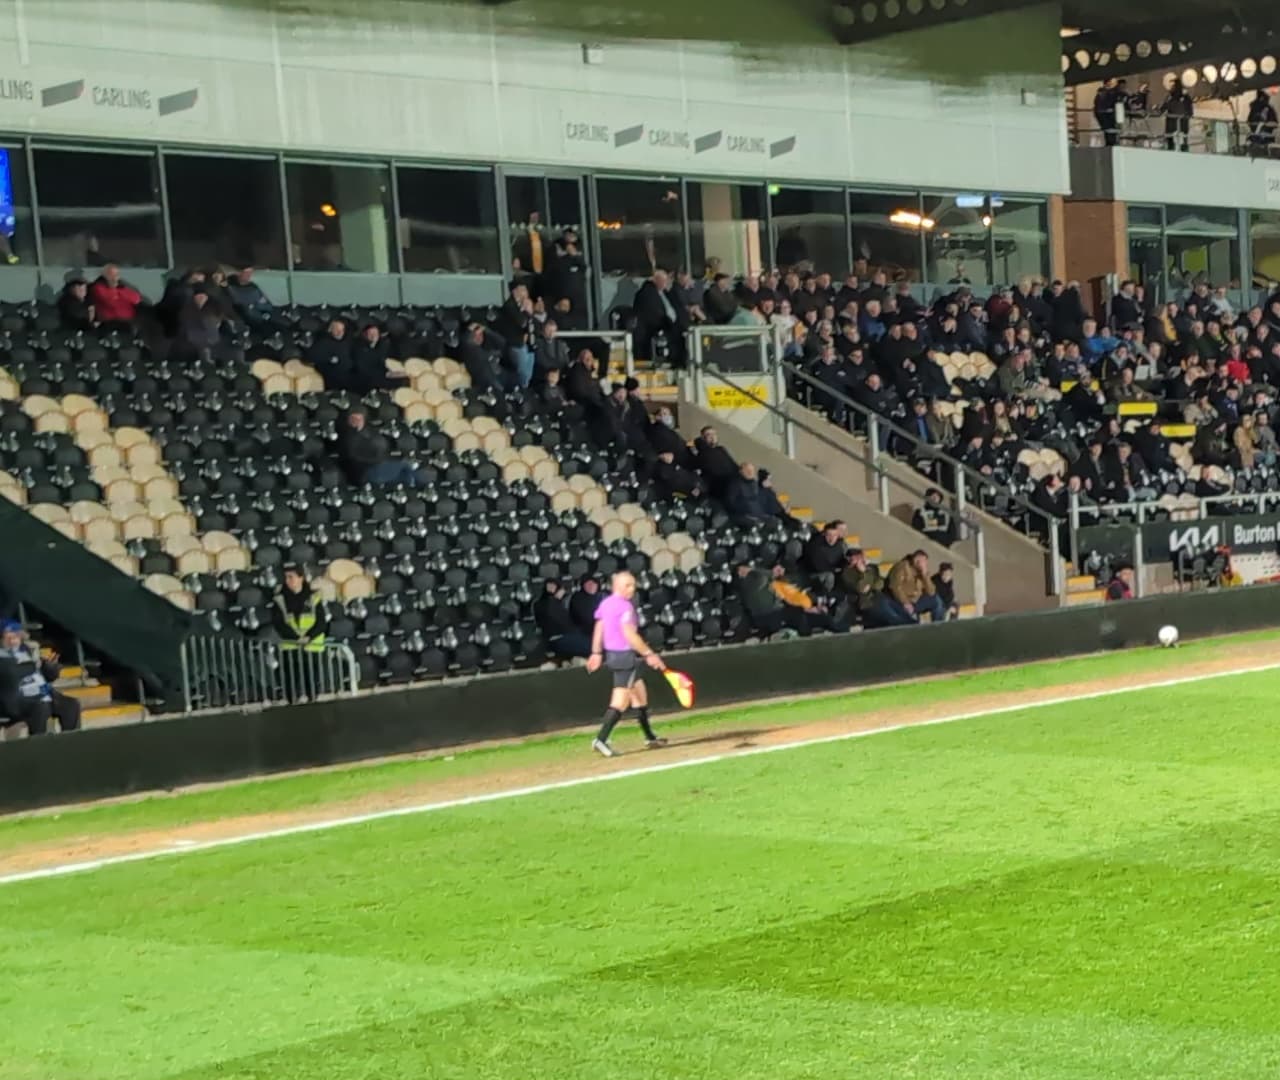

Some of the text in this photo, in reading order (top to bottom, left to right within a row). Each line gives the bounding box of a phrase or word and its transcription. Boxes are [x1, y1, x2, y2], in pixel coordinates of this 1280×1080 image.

[0, 78, 152, 109] LING CARLING
[1234, 523, 1276, 545] Burton
